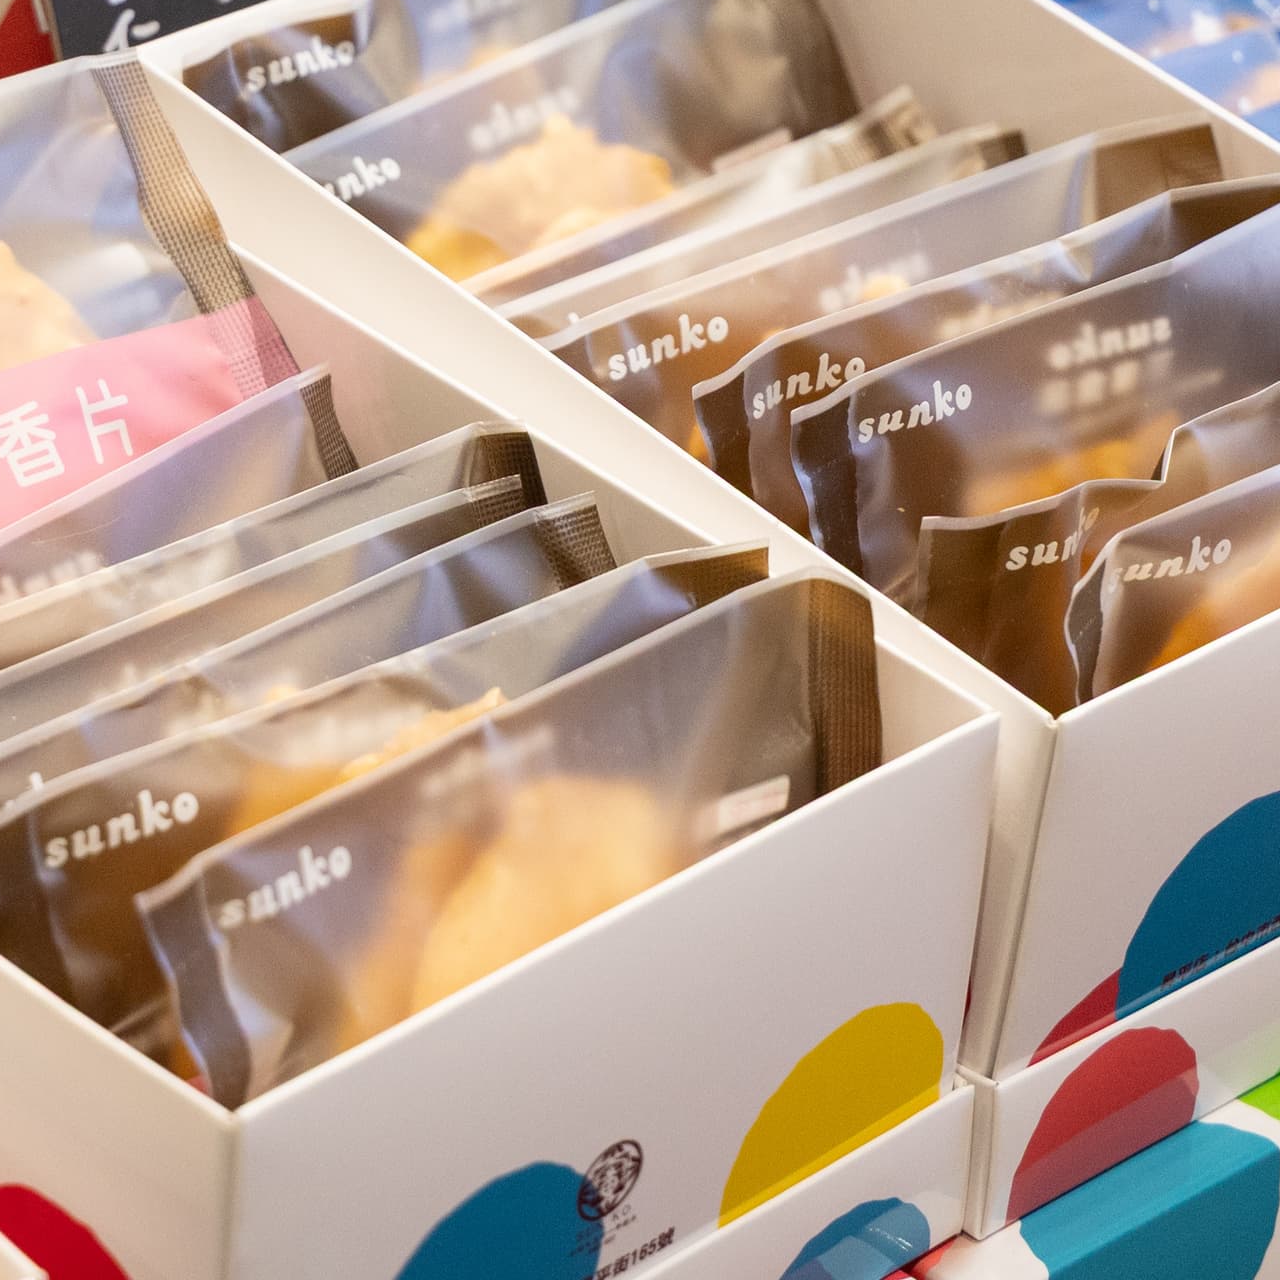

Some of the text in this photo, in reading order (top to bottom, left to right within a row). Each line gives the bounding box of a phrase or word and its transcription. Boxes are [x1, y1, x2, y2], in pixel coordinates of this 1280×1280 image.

[245, 34, 356, 95] sunko
[607, 313, 730, 382] sunko
[752, 352, 867, 420] sunko
[857, 380, 973, 444] sunko
[44, 788, 200, 869] sunko
[219, 844, 353, 929] sunko
